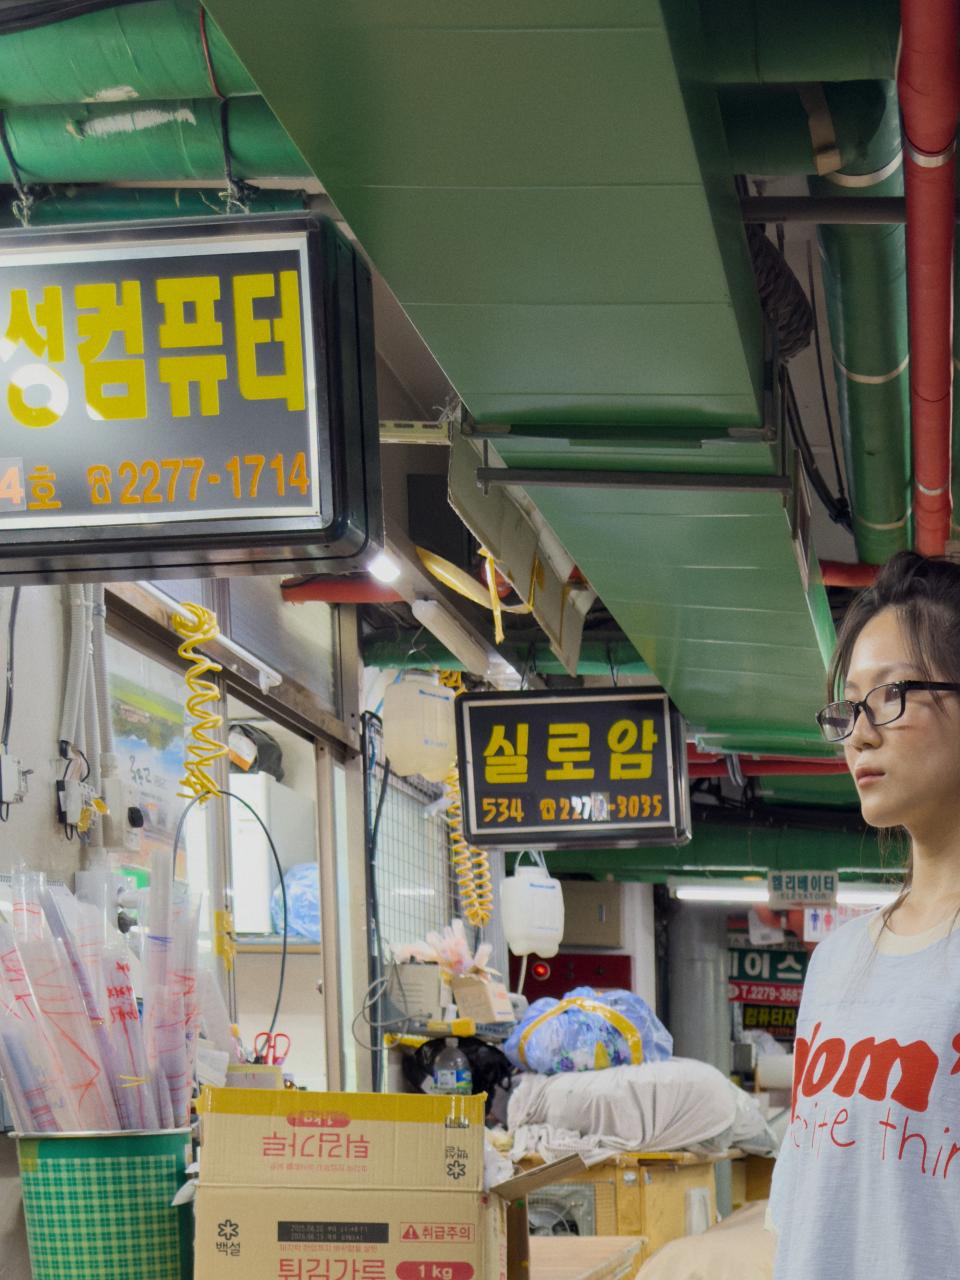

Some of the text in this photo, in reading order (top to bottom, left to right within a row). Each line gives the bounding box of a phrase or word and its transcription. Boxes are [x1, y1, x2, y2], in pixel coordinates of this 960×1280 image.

[0, 270, 306, 428] 성컴퓨터
[118, 451, 310, 504] 2277-1714
[483, 719, 658, 784] 실로암
[483, 797, 525, 823] 534
[422, 1225, 471, 1241] 취급주의
[215, 1241, 241, 1257] 백설
[418, 1263, 453, 1280] 1 kg
